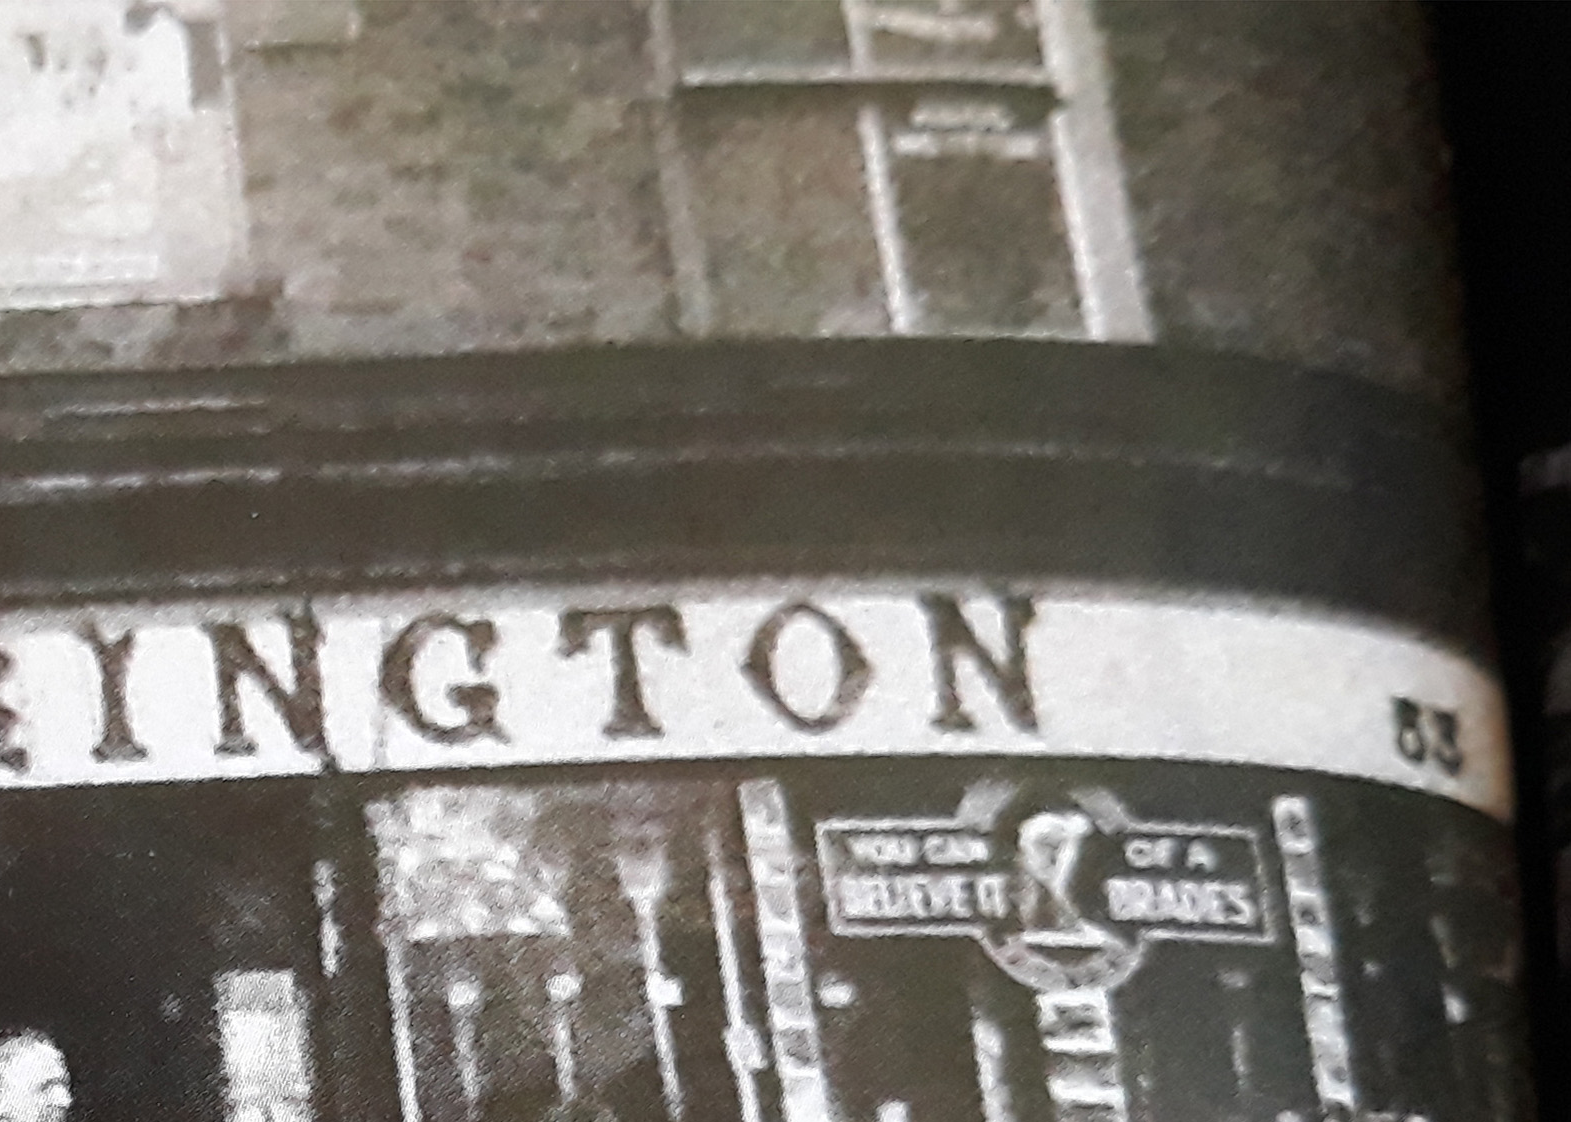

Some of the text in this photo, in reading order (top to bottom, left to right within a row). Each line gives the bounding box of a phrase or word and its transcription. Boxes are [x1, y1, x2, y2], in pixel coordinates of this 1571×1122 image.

[1391, 696, 1464, 777] 53
[851, 834, 914, 864] YOU
[1186, 839, 1217, 872] A
